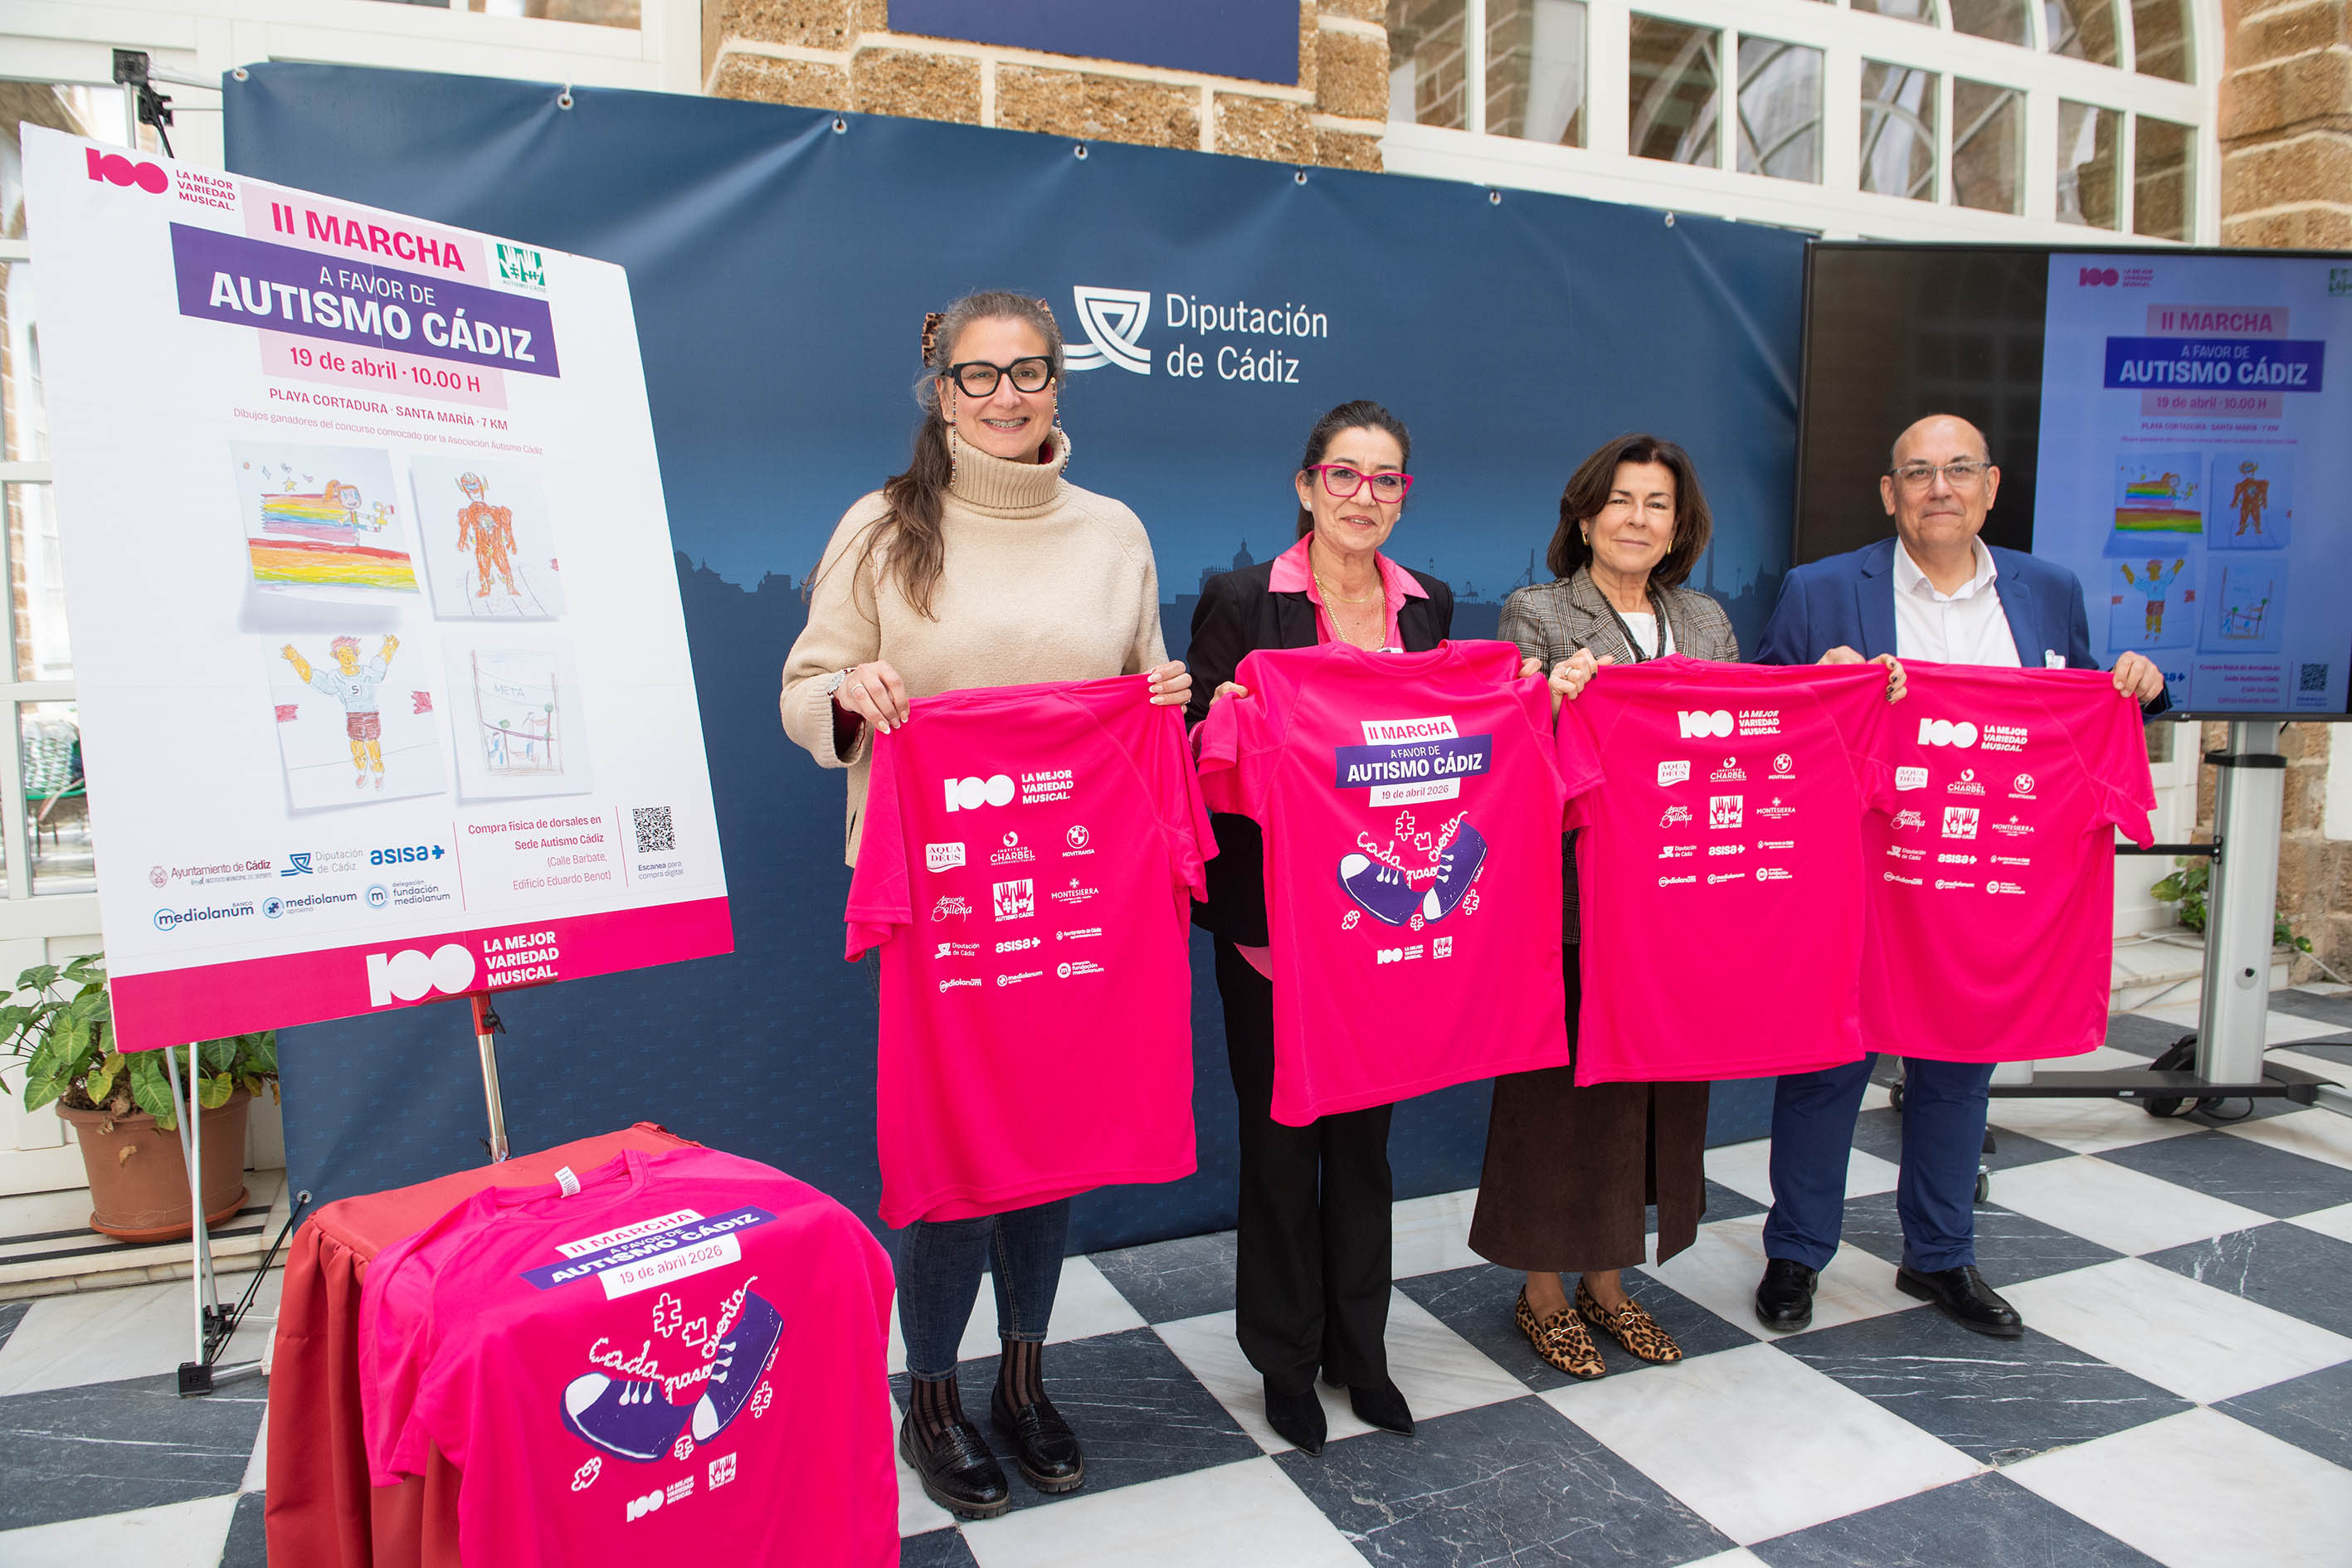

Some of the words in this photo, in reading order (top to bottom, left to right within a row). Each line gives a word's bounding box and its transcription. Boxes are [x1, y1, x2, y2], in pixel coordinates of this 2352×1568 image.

[85, 147, 168, 194] 100
[176, 169, 191, 180] LA
[193, 172, 233, 190] MEJOR
[178, 181, 236, 201] VARIEDAD
[179, 191, 235, 212] MUSICAL.
[271, 202, 295, 235] II
[305, 210, 465, 271] MARCHA
[319, 265, 333, 286] A
[339, 270, 404, 299] FAVOR
[410, 284, 436, 307] DE
[209, 271, 411, 341] AUTISMO
[421, 307, 536, 363] CÁDIZ
[1166, 293, 1327, 338] Diputación
[2161, 312, 2174, 330] II
[2179, 312, 2273, 333] MARCHA
[2181, 345, 2189, 358] A
[2192, 345, 2231, 358] FAVOR
[2233, 346, 2250, 359] DE
[290, 347, 313, 368] 19
[319, 350, 345, 373] de
[352, 357, 397, 381] abril
[411, 367, 462, 390] 10.00
[467, 376, 480, 393] H
[1166, 343, 1203, 377] de
[1217, 346, 1299, 383] Cádiz
[2119, 359, 2232, 385] AUTISMO
[2237, 356, 2308, 386] CÁDIZ
[269, 387, 310, 404] PLAYA
[313, 394, 388, 414] CORTADURA
[396, 406, 435, 421] SANTA
[437, 411, 475, 426] MARÍA
[481, 417, 487, 428] 7
[490, 418, 508, 431] KM
[2157, 397, 2169, 408] 19
[2172, 397, 2187, 408] de
[2189, 396, 2217, 409] abril
[233, 407, 269, 421] Dibujos
[270, 411, 318, 427] ganadores
[319, 418, 334, 429] del
[335, 421, 375, 435] concurso
[377, 425, 422, 440] convocado
[423, 431, 438, 443] por
[438, 432, 446, 443] la
[448, 434, 489, 448] Asociación
[491, 439, 521, 453] Autismo
[493, 683, 525, 698] META
[1678, 710, 1734, 738] 100
[1739, 710, 1750, 718] LA
[1739, 718, 1780, 727] VARIEDAD
[1368, 727, 1378, 740] II
[1381, 721, 1452, 740] MARCHA
[1740, 727, 1780, 736] MUSICAL.
[1917, 718, 1978, 748] 100
[1984, 725, 1995, 733] LA
[1997, 726, 2028, 736] MEJOR
[1984, 733, 2028, 745] VARIEDAD
[1390, 750, 1397, 758] A
[1398, 747, 1427, 758] FAVOR
[1428, 745, 1441, 756] DE
[1981, 743, 2023, 752] MUSICAL.
[1022, 773, 1035, 782] LA
[1036, 770, 1072, 782] MEJOR
[1347, 759, 1429, 782] AUTISMO
[1434, 751, 1483, 775] CÁDIZ
[1710, 772, 1746, 780] CHARBEL
[944, 774, 1015, 812] 100
[1022, 781, 1074, 793] VARIEDAD
[1382, 791, 1390, 800] 19
[1393, 790, 1404, 799] de
[1405, 787, 1425, 798] abril
[1427, 784, 1449, 796] 2026
[1947, 783, 1986, 794] CHARBEL
[1022, 791, 1070, 805] MUSICAL.
[468, 822, 507, 835] Compra
[536, 819, 548, 829] de
[549, 816, 588, 828] dorsales
[590, 816, 601, 825] en
[514, 840, 538, 850] Sede
[541, 835, 578, 848] Autismo
[580, 833, 604, 844] Cádiz
[928, 845, 962, 854] AQUA
[1357, 830, 1405, 871] Cada
[1406, 865, 1440, 890] paso
[1429, 811, 1468, 862] cuenta
[315, 848, 363, 862] Diputación
[547, 855, 571, 868] (Calle
[572, 853, 607, 864] Barbate,
[990, 850, 1035, 863] CHARBEL
[171, 863, 231, 879] Ayuntamiento
[233, 863, 244, 873] de
[246, 859, 271, 871] Cádiz
[317, 864, 329, 874] de
[332, 861, 357, 872] Cádiz
[638, 863, 666, 871] Escanea
[667, 860, 682, 870] para
[638, 870, 664, 880] compra
[665, 868, 684, 879] digital
[513, 877, 545, 890] Edificio
[547, 874, 582, 887] Eduardo
[584, 870, 611, 882] Benot)
[286, 892, 357, 908] mediolanum
[393, 885, 438, 896] fundación
[395, 893, 450, 906] mediolanum
[1051, 888, 1099, 899] MONTESIERRA
[158, 906, 254, 926] mediolanum
[483, 939, 499, 953] LA
[505, 931, 556, 949] MEJOR
[485, 947, 559, 969] VARIEDAD
[366, 943, 475, 1007] 100
[488, 965, 558, 986] MUSICAL.
[569, 1244, 582, 1254] II
[591, 1213, 694, 1248] MARCHA
[610, 1247, 621, 1255] A
[621, 1235, 664, 1252] FAVOR
[665, 1228, 686, 1239] DE
[551, 1238, 679, 1283] AUTISMO
[679, 1212, 761, 1242] CÁDIZ
[620, 1271, 635, 1284] 19
[637, 1266, 655, 1278] de
[657, 1256, 687, 1274] abril
[689, 1244, 723, 1264] 2026
[589, 1337, 665, 1381] Cada
[665, 1361, 716, 1405] paso
[702, 1275, 757, 1358] cuenta
